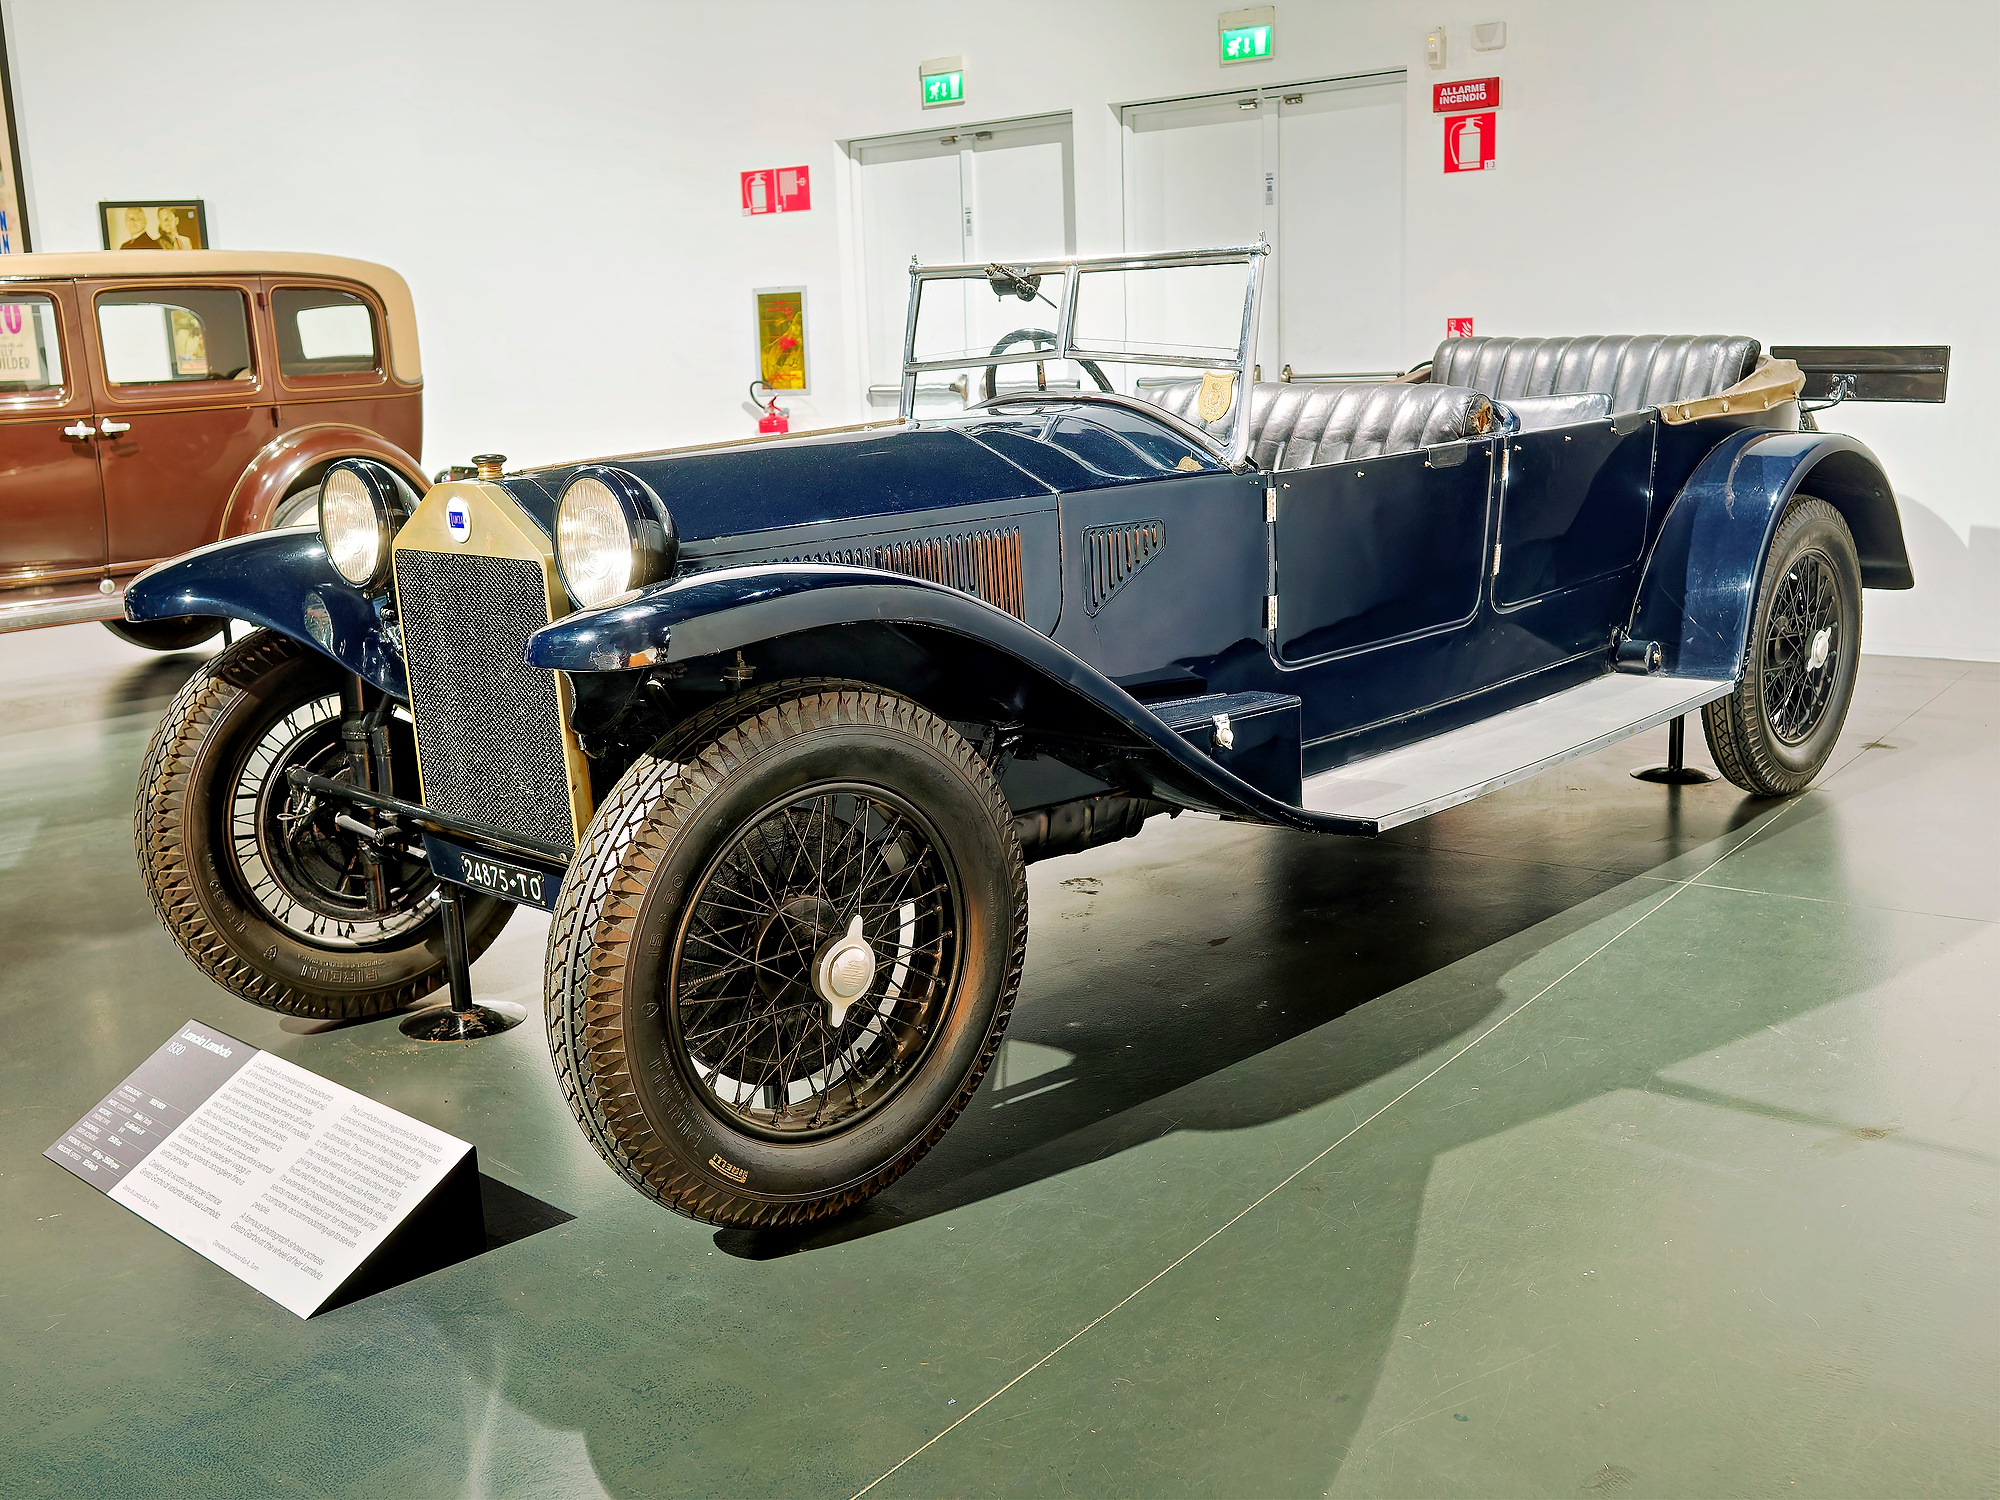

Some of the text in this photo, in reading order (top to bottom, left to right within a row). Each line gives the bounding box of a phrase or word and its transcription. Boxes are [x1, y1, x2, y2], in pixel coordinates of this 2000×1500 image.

[1440, 92, 1487, 104] INCENDIO
[1441, 83, 1486, 96] ALLARME
[0, 356, 30, 370] ILDER
[300, 964, 379, 983] PIRELLI
[166, 1041, 186, 1056] 1930
[181, 1029, 232, 1058] Lancia Lambda
[332, 1122, 358, 1138] innovative
[355, 1134, 376, 1147] models
[387, 1148, 407, 1163] history
[357, 1109, 379, 1123] Lambda
[387, 1124, 414, 1139] regarded
[417, 1137, 443, 1153] Vincenzo
[359, 1124, 392, 1142] masterpiece
[424, 1154, 441, 1166] most
[295, 1157, 313, 1170] giving
[344, 1181, 364, 1195] Lancia
[361, 1190, 381, 1204] Artena
[313, 1152, 333, 1164] model
[328, 1161, 343, 1171] went
[353, 1174, 384, 1192] production
[328, 1145, 340, 1155] last
[350, 1158, 364, 1168] nine
[362, 1164, 380, 1176] series
[376, 1172, 406, 1188] produced
[375, 1156, 395, 1171] display
[392, 1164, 421, 1182] belonged
[708, 1153, 749, 1184] PIRELLI
[285, 1178, 311, 1194] extended
[307, 1190, 328, 1204] chassis
[345, 1210, 367, 1224] central
[361, 1218, 378, 1232] jump
[288, 1164, 312, 1180] featured
[316, 1180, 344, 1198] traditional
[340, 1193, 362, 1208] torpedo
[359, 1203, 376, 1216] body
[270, 1183, 362, 1238] seats made ideal traveling
[287, 1207, 329, 1234] accommodating
[338, 1236, 357, 1249] seven
[230, 1221, 246, 1234] Greta
[243, 1229, 261, 1243] Garbo
[271, 1247, 290, 1260] wheel
[243, 1214, 325, 1266] famous photograph shows actress
